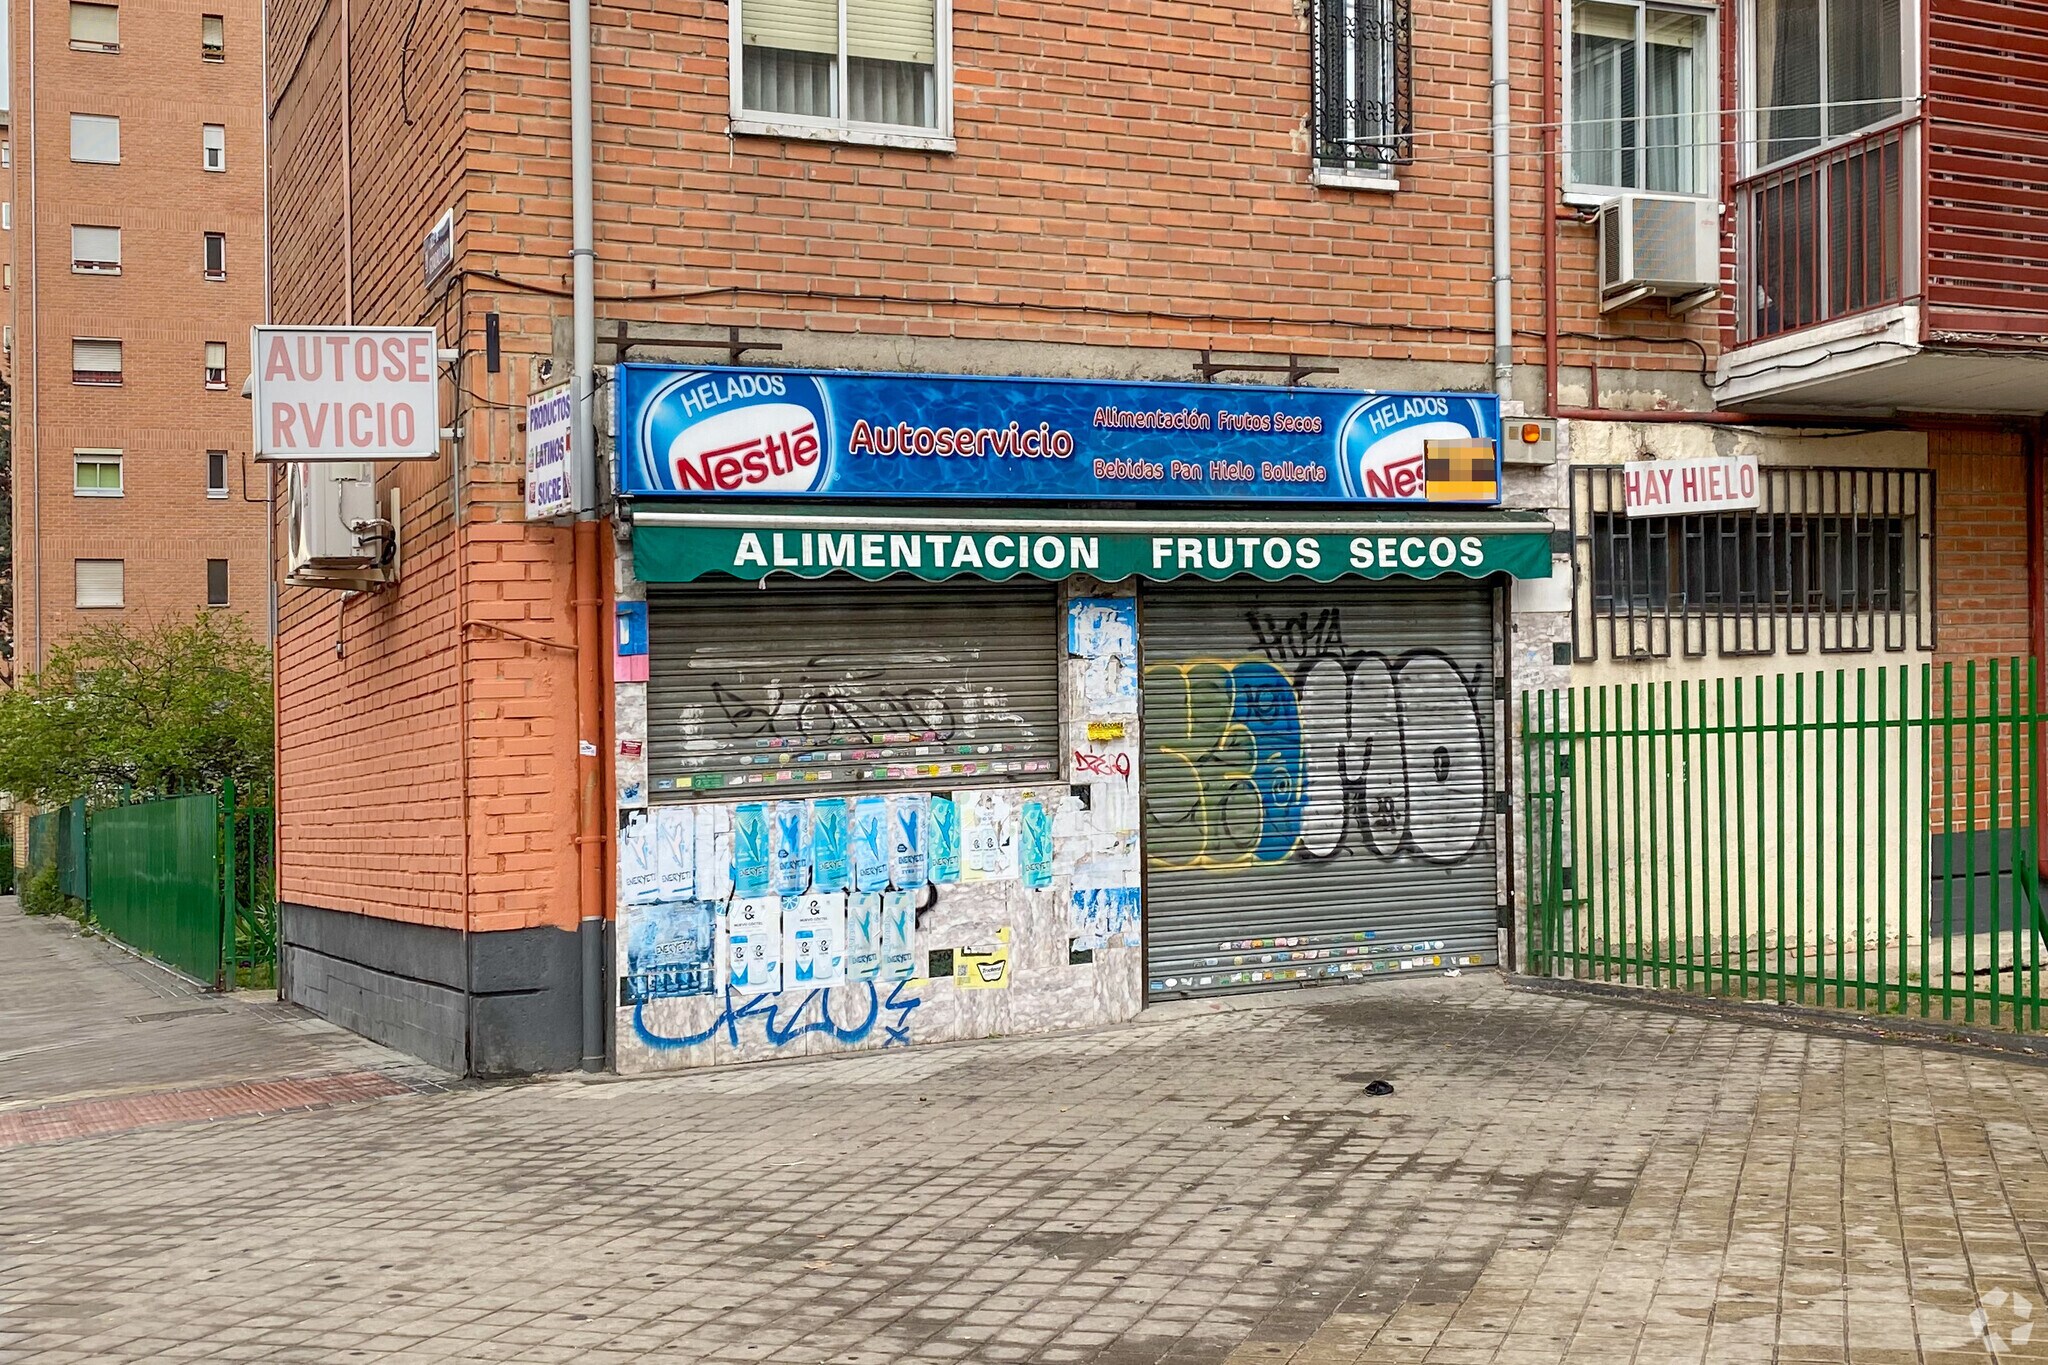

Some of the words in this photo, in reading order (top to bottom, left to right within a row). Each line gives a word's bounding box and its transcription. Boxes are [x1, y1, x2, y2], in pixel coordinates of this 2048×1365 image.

[264, 335, 430, 382] AUTOSE
[530, 394, 571, 432] PRODUCTOS
[680, 374, 787, 418] HELADOS
[271, 402, 416, 448] RVICIO
[1093, 406, 1211, 431] Alimentación
[1217, 410, 1271, 432] Frutos
[1273, 411, 1323, 433] Secos
[1368, 397, 1449, 434] HELADOS
[535, 436, 565, 469] LATINOS
[848, 419, 1074, 459] Autoservicio
[1093, 458, 1164, 481] Bebidas
[1171, 460, 1202, 481] Pan
[1210, 459, 1255, 482] Hielo
[1625, 468, 1674, 507] HAY
[1682, 463, 1756, 503] HIELO
[538, 476, 562, 506] SUCRE
[733, 532, 1099, 570] ALIMENTACION
[1152, 537, 1321, 570] FRUTOS
[1349, 536, 1485, 568] SECOS
